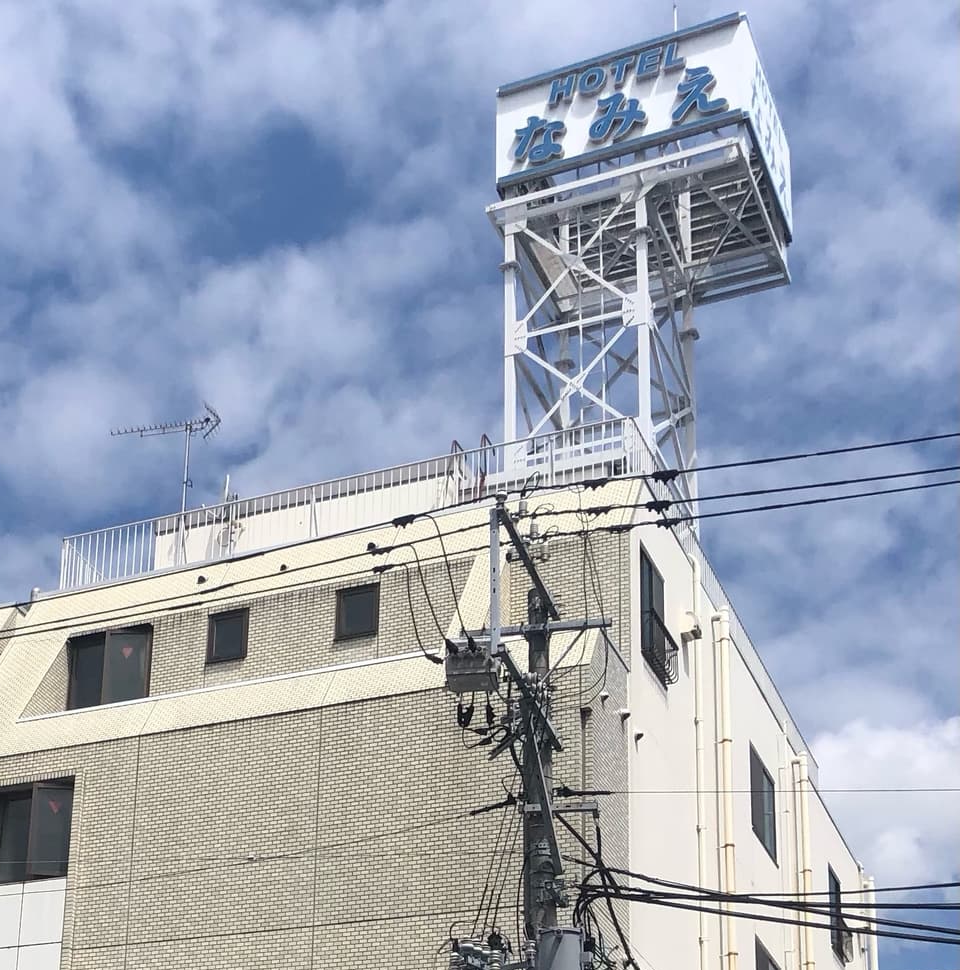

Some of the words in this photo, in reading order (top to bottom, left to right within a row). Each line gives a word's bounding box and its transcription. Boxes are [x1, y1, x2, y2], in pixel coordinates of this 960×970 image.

[514, 66, 728, 162] なみえ
[548, 41, 686, 108] HOTEL
